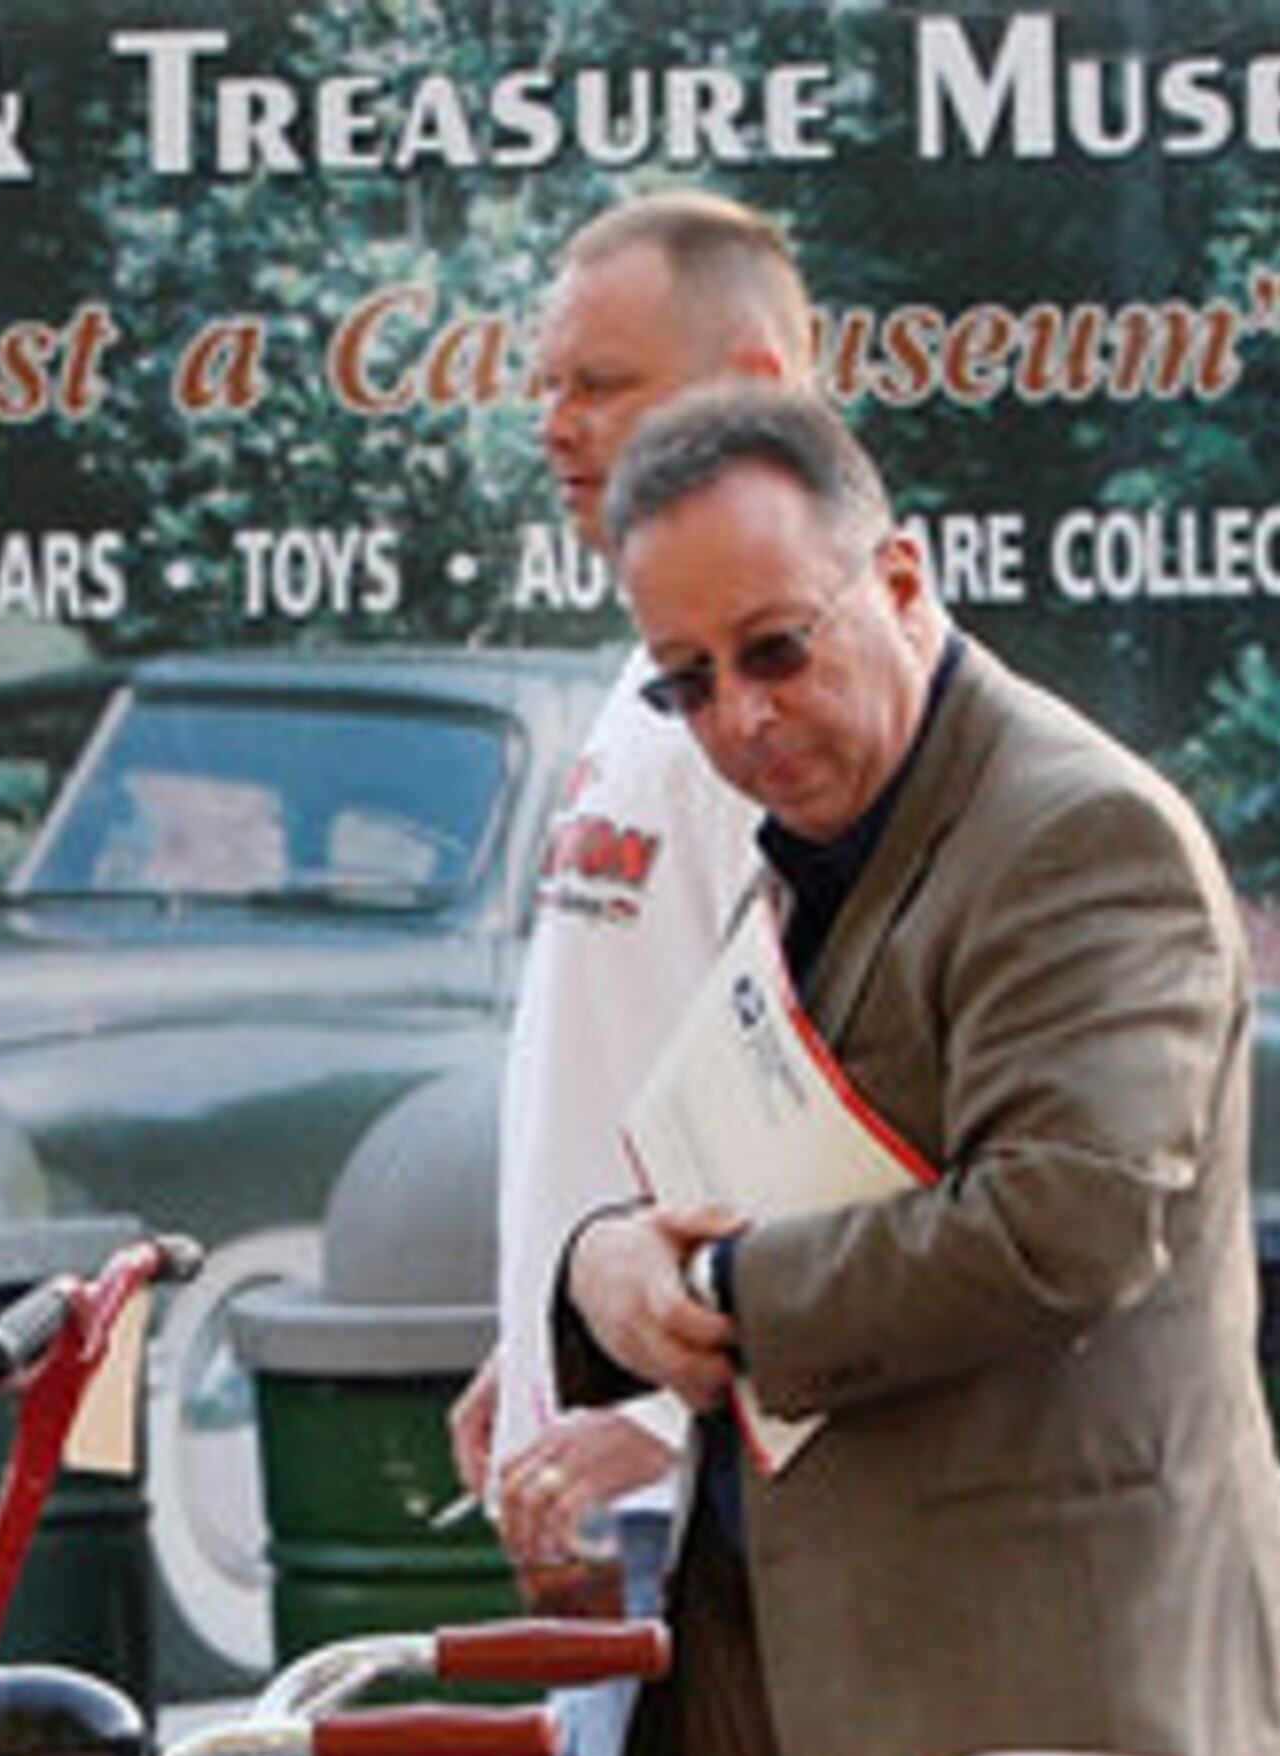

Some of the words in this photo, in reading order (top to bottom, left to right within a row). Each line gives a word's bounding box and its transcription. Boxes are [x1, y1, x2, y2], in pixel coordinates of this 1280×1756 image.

[110, 30, 834, 174] TREASURE
[173, 312, 268, 412] a
[328, 280, 542, 412] Ca
[234, 526, 402, 614] TOYS
